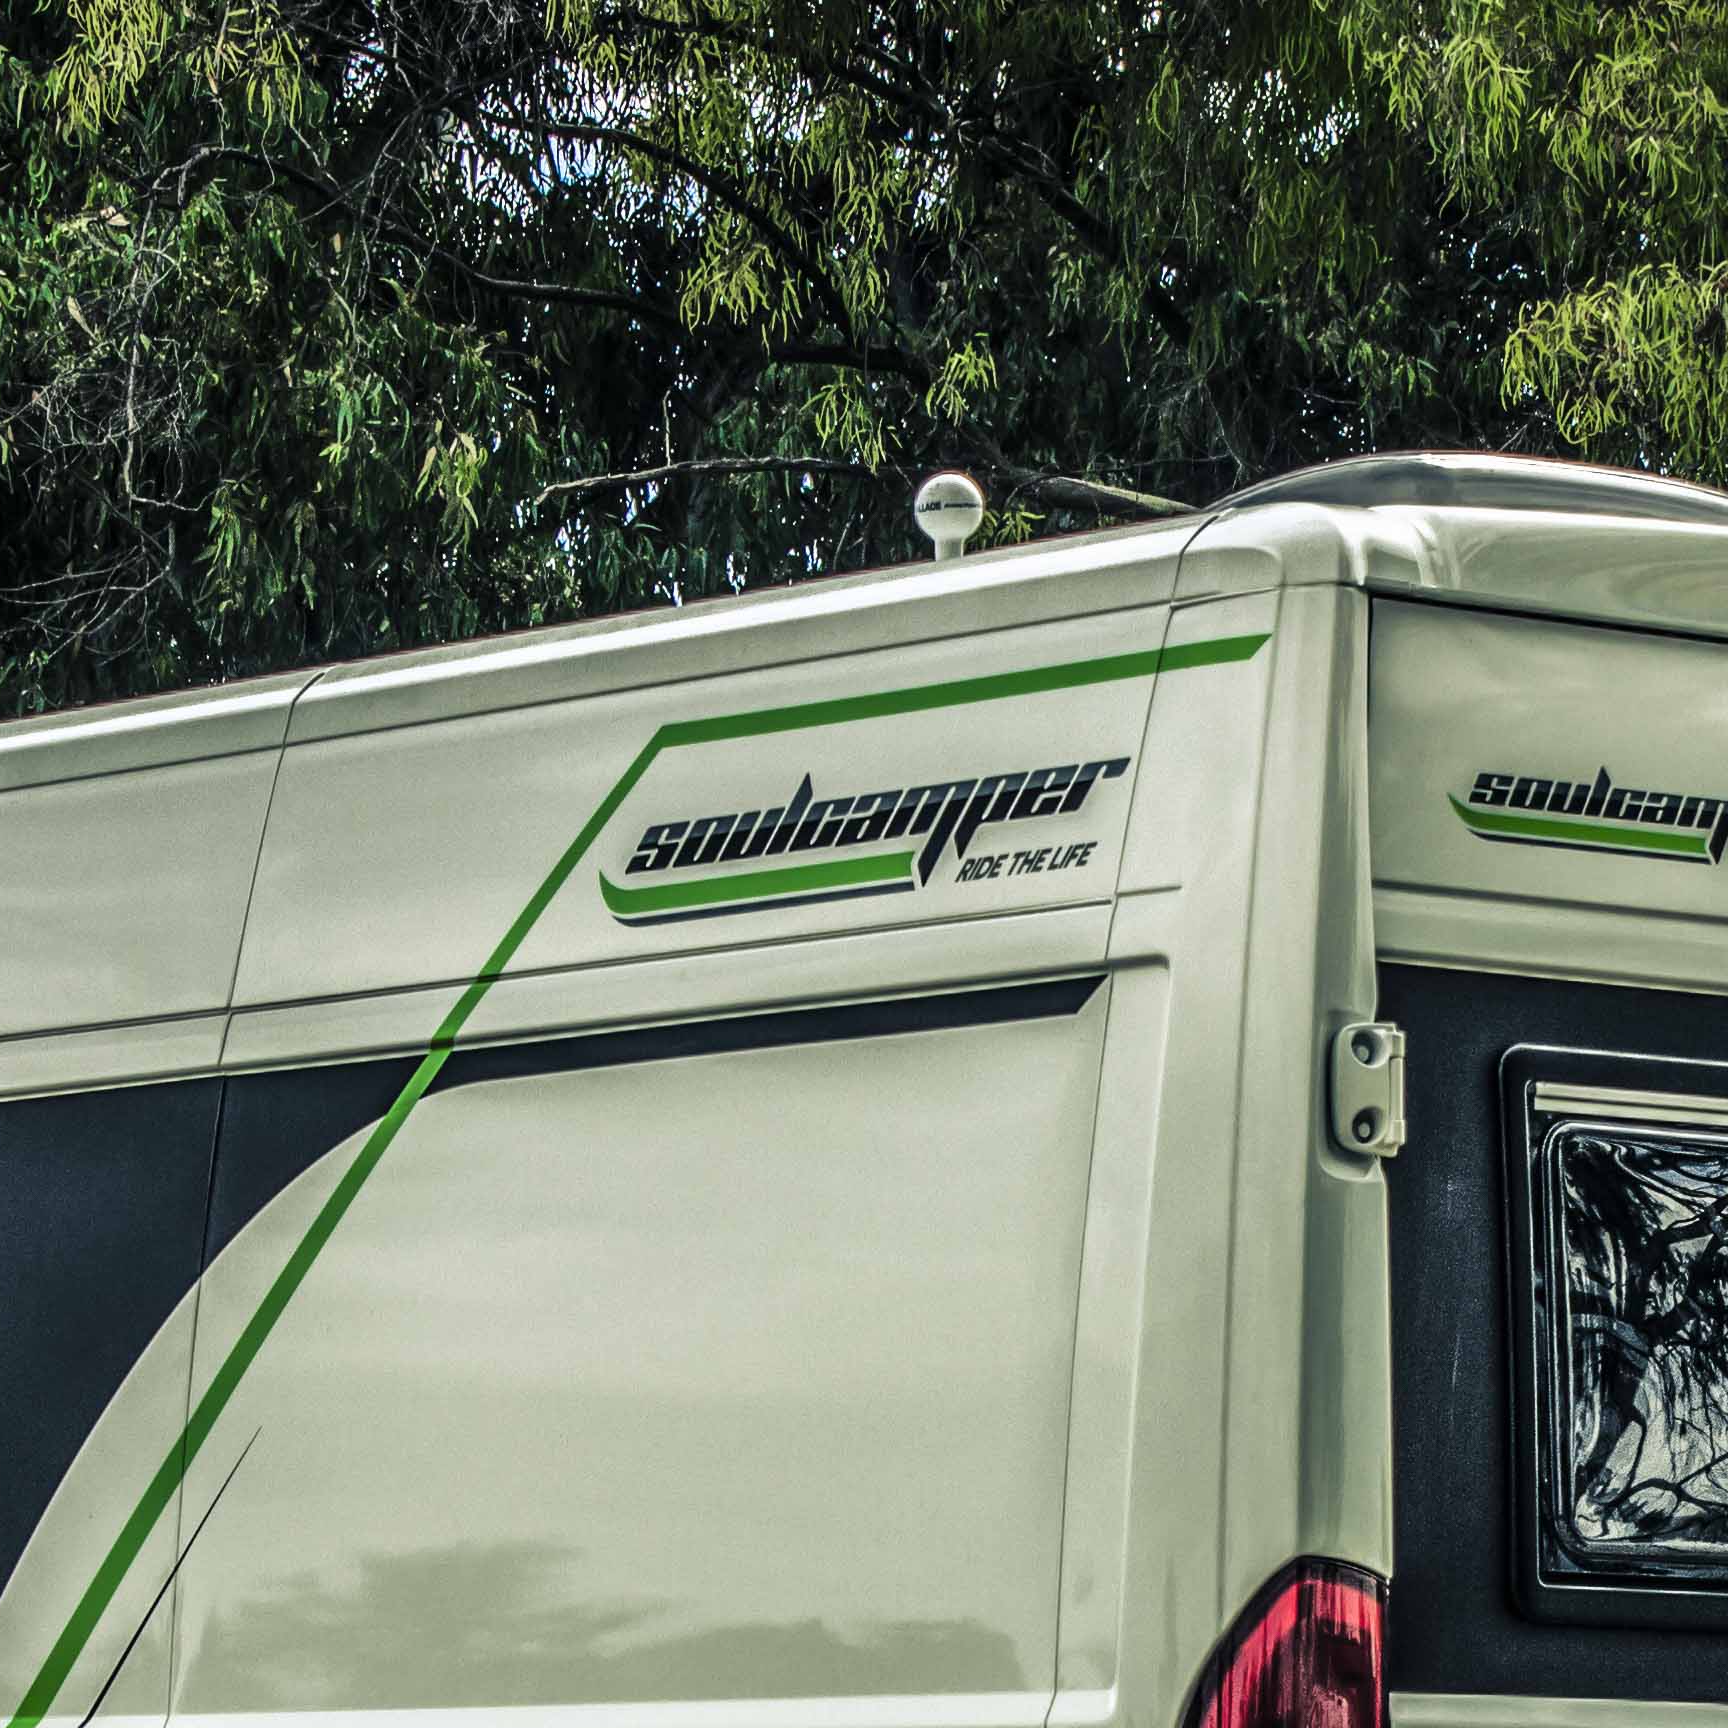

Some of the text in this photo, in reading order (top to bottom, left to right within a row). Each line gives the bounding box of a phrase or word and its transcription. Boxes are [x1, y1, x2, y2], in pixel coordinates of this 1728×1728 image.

[624, 756, 1132, 888] soulcamper
[955, 841, 1098, 883] RIDE THE LIFE
